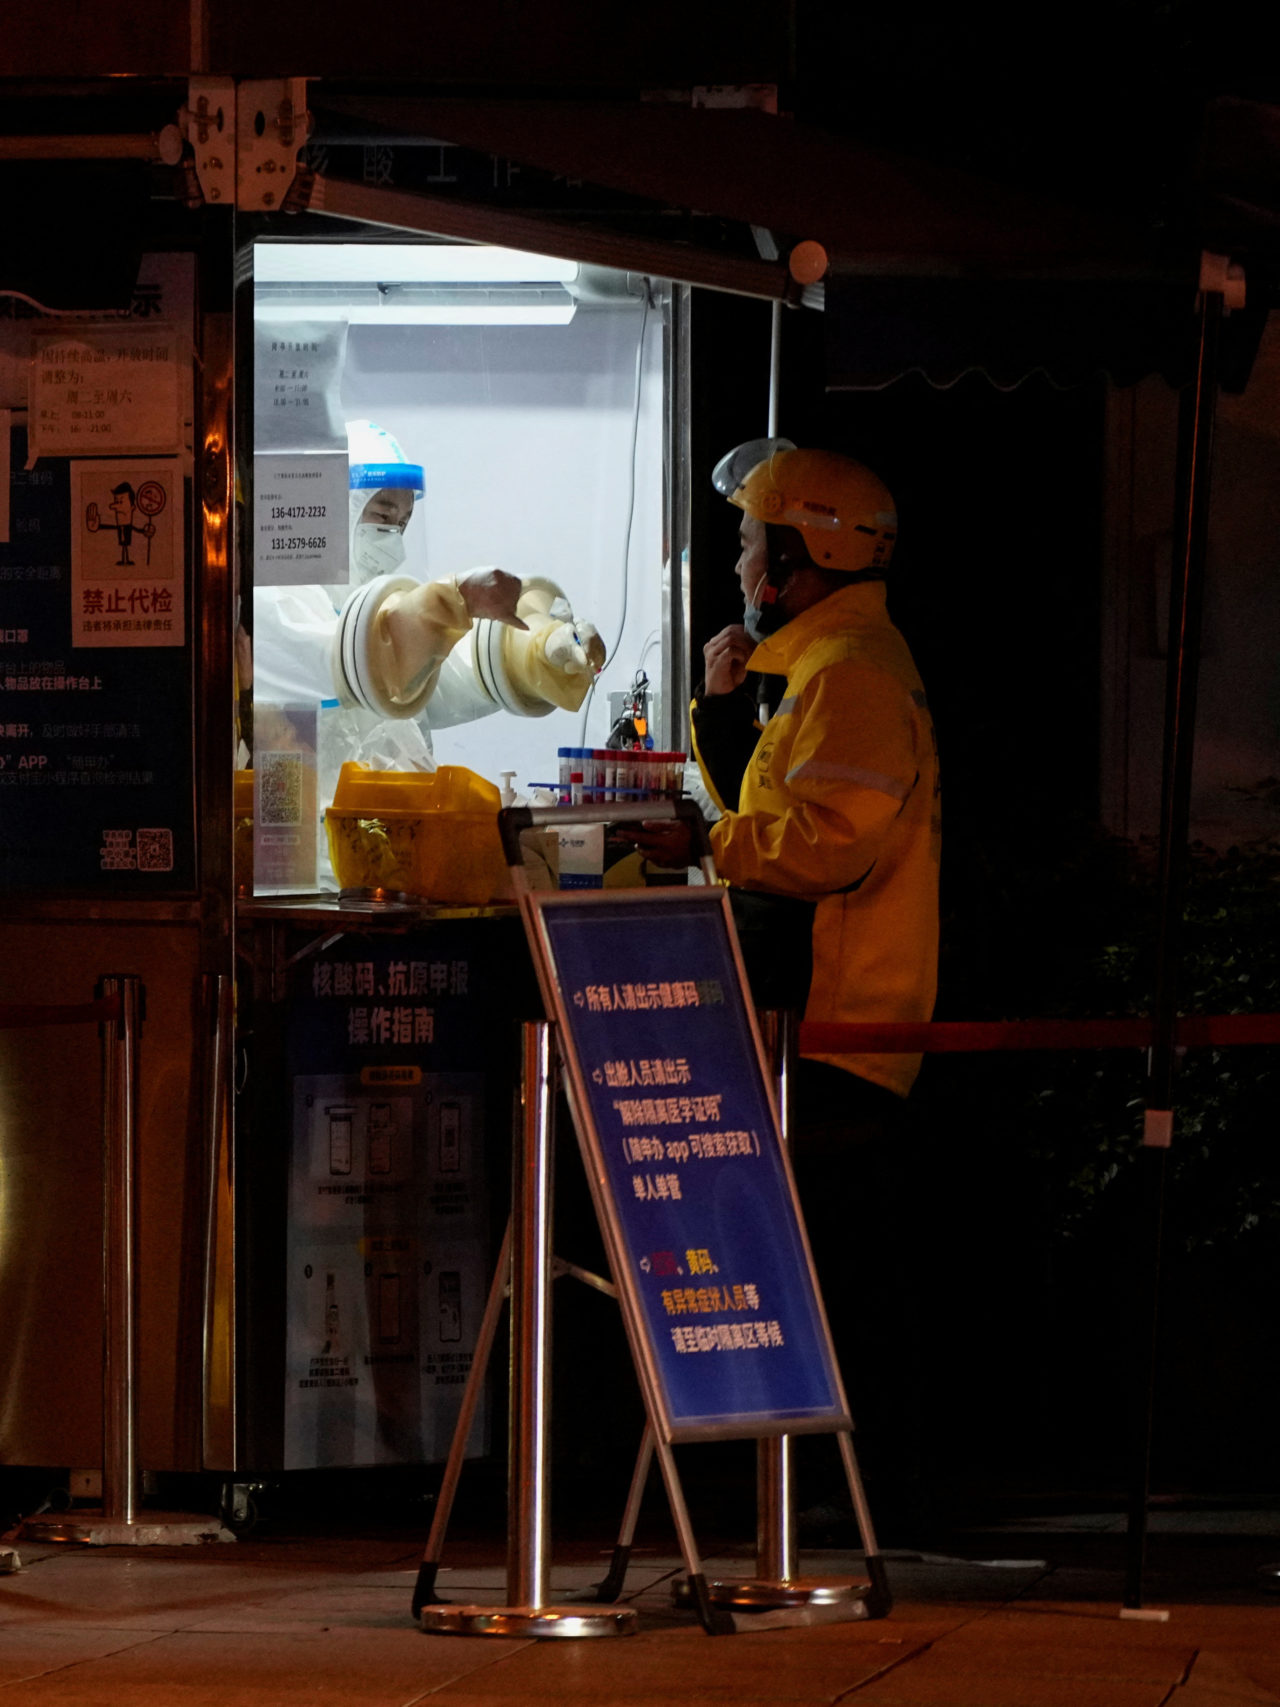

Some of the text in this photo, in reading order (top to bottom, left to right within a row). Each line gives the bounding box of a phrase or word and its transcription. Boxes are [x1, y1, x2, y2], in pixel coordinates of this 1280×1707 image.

[66, 389, 133, 406] 周二至周六
[271, 506, 326, 519] 136-4172-2232
[271, 536, 327, 550] 131-2579-6626
[82, 587, 172, 615] 禁止代检
[312, 960, 470, 998] 核酸码、抗原申报
[347, 1006, 436, 1045] 操作指南
[665, 1139, 690, 1163] app
[632, 1173, 683, 1202] 单人单管
